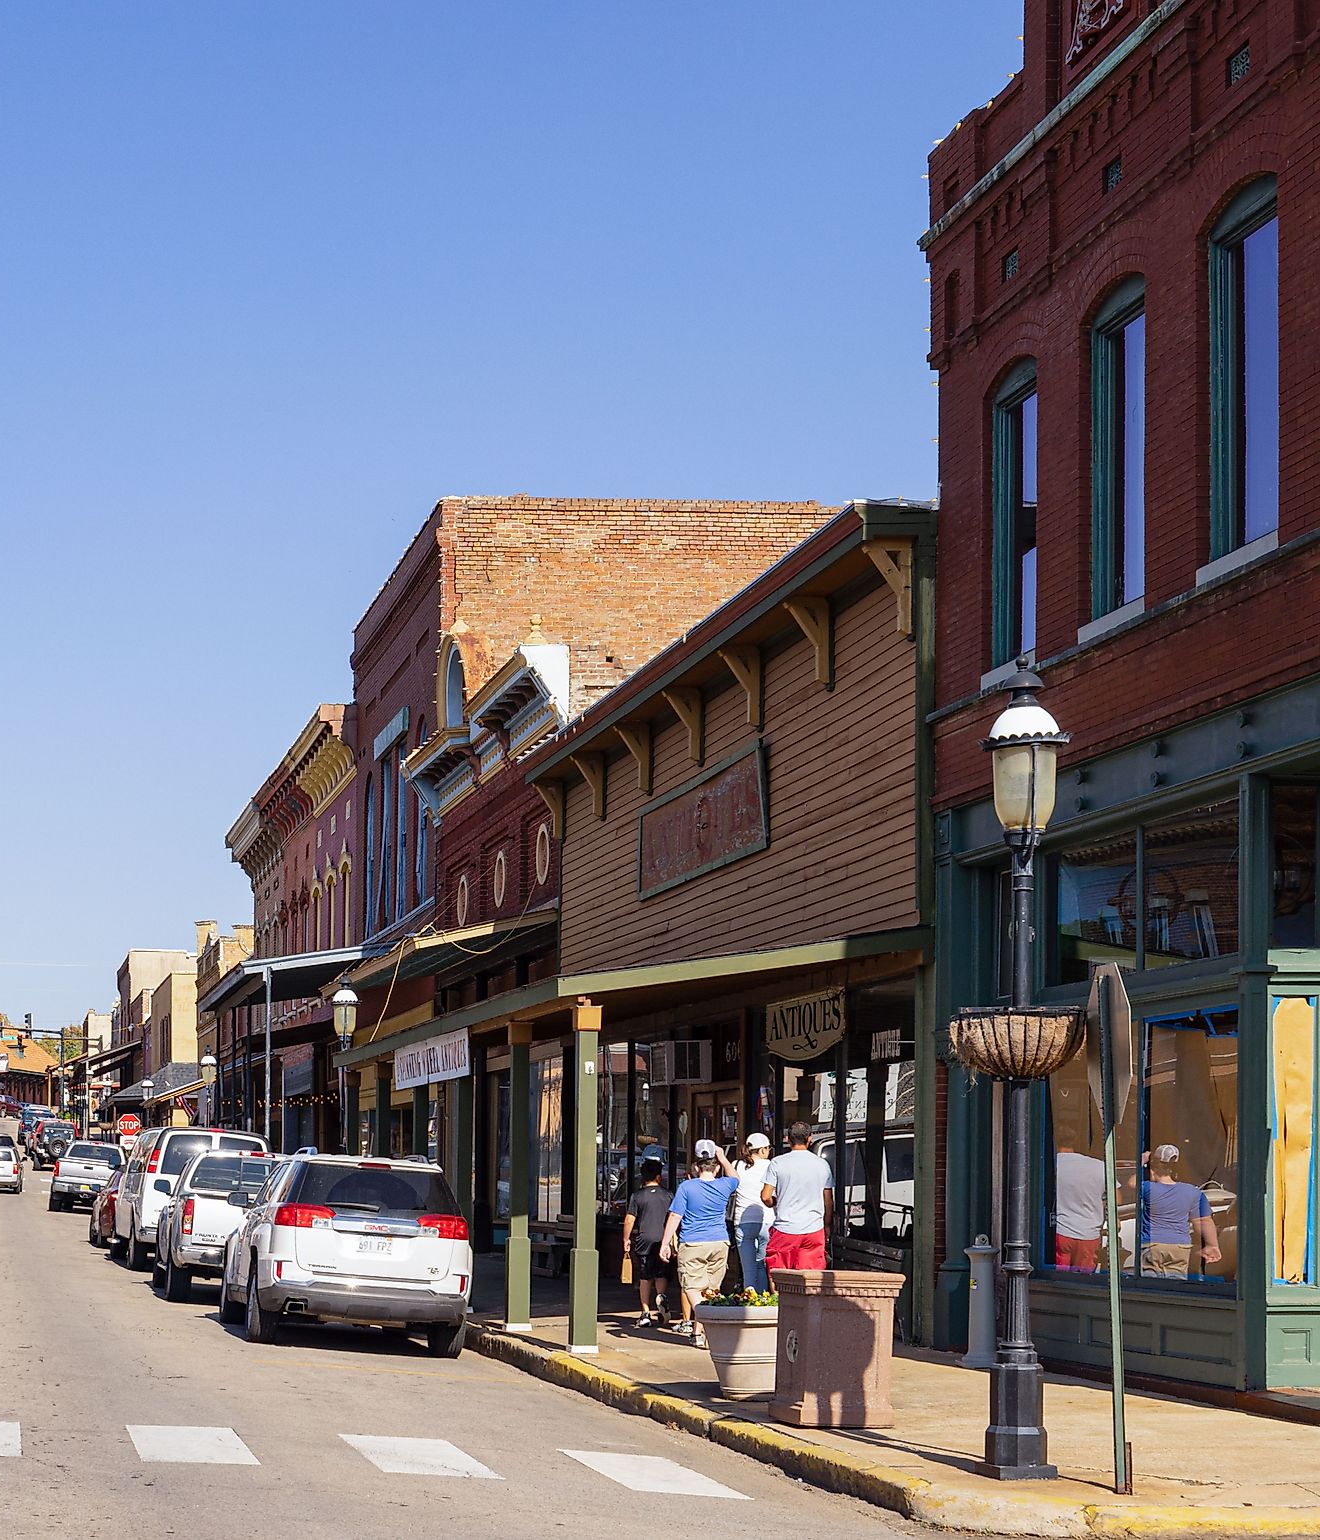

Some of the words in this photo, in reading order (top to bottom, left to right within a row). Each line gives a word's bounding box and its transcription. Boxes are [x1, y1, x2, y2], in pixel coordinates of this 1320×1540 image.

[770, 999, 840, 1049] ANTIQUES
[871, 1029, 900, 1060] ANTIQUE
[120, 1120, 139, 1130] STOP
[363, 1224, 389, 1232] GMC
